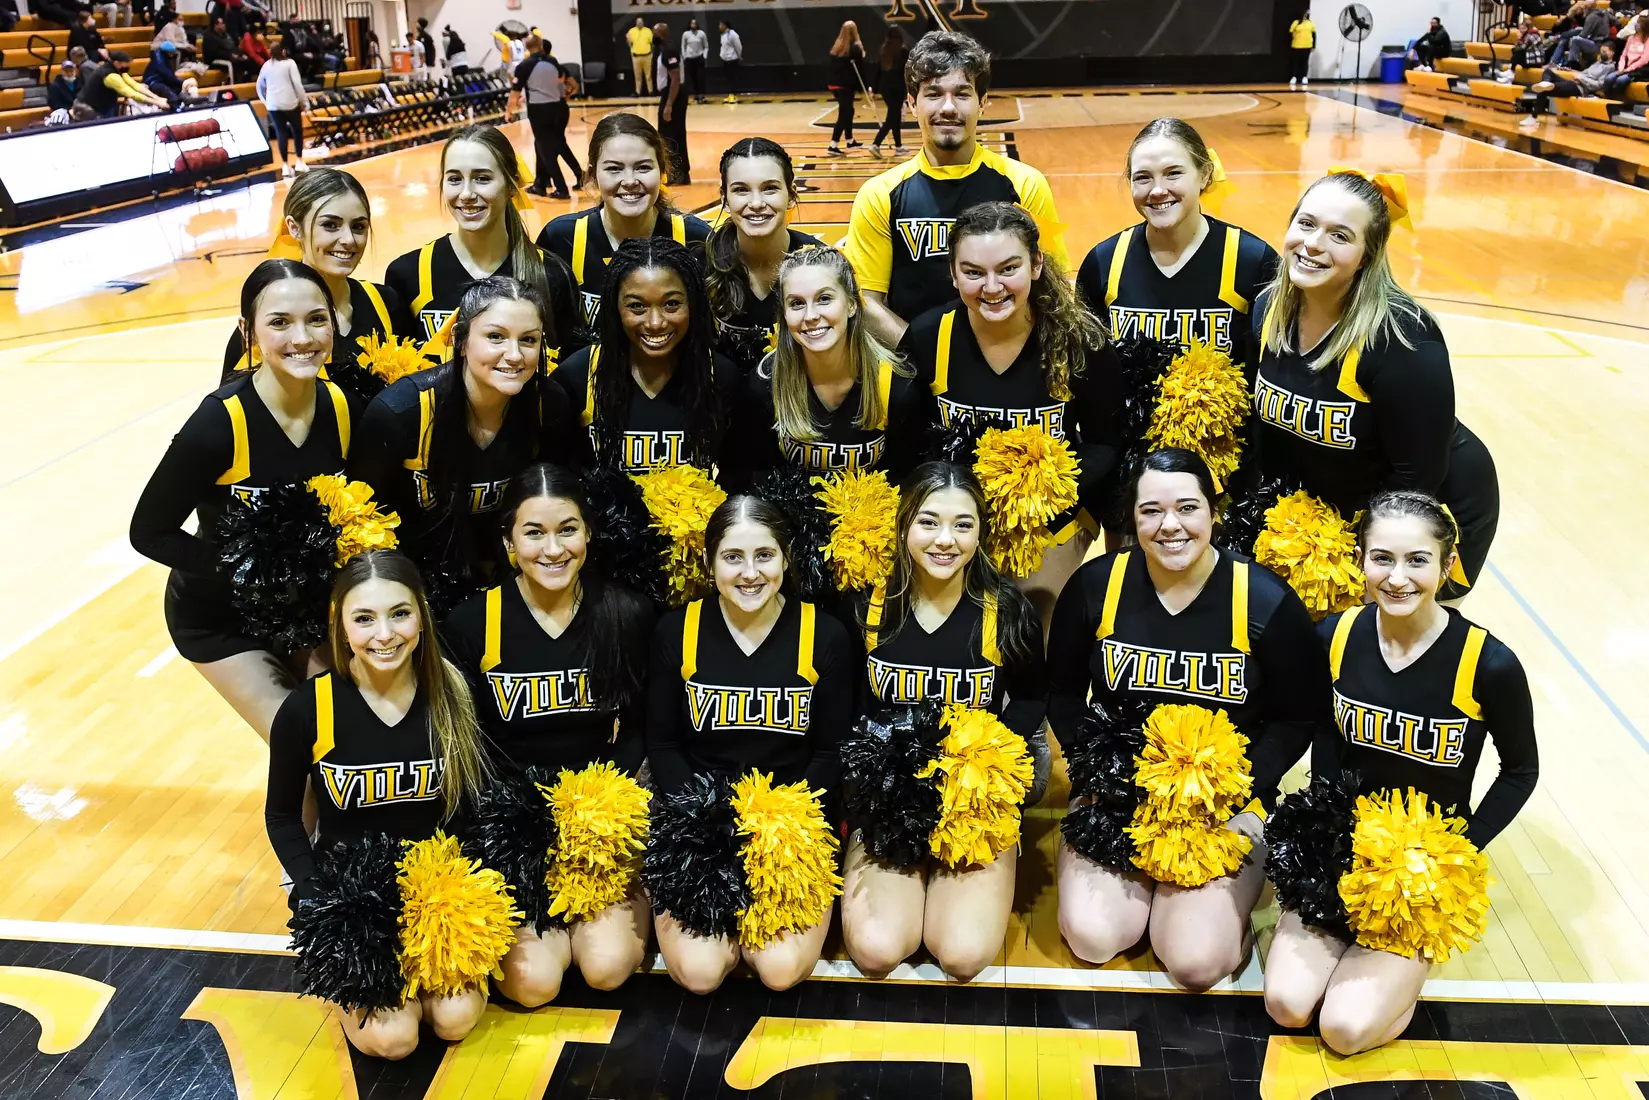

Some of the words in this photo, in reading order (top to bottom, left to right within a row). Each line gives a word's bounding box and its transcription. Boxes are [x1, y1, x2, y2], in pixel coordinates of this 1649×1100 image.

[486, 669, 598, 721] VILL
[867, 655, 995, 709] VILLE
[1101, 639, 1248, 704] VILLE
[685, 681, 813, 735] VILLE
[1332, 687, 1468, 767] VILLE
[319, 758, 443, 810] VILL
